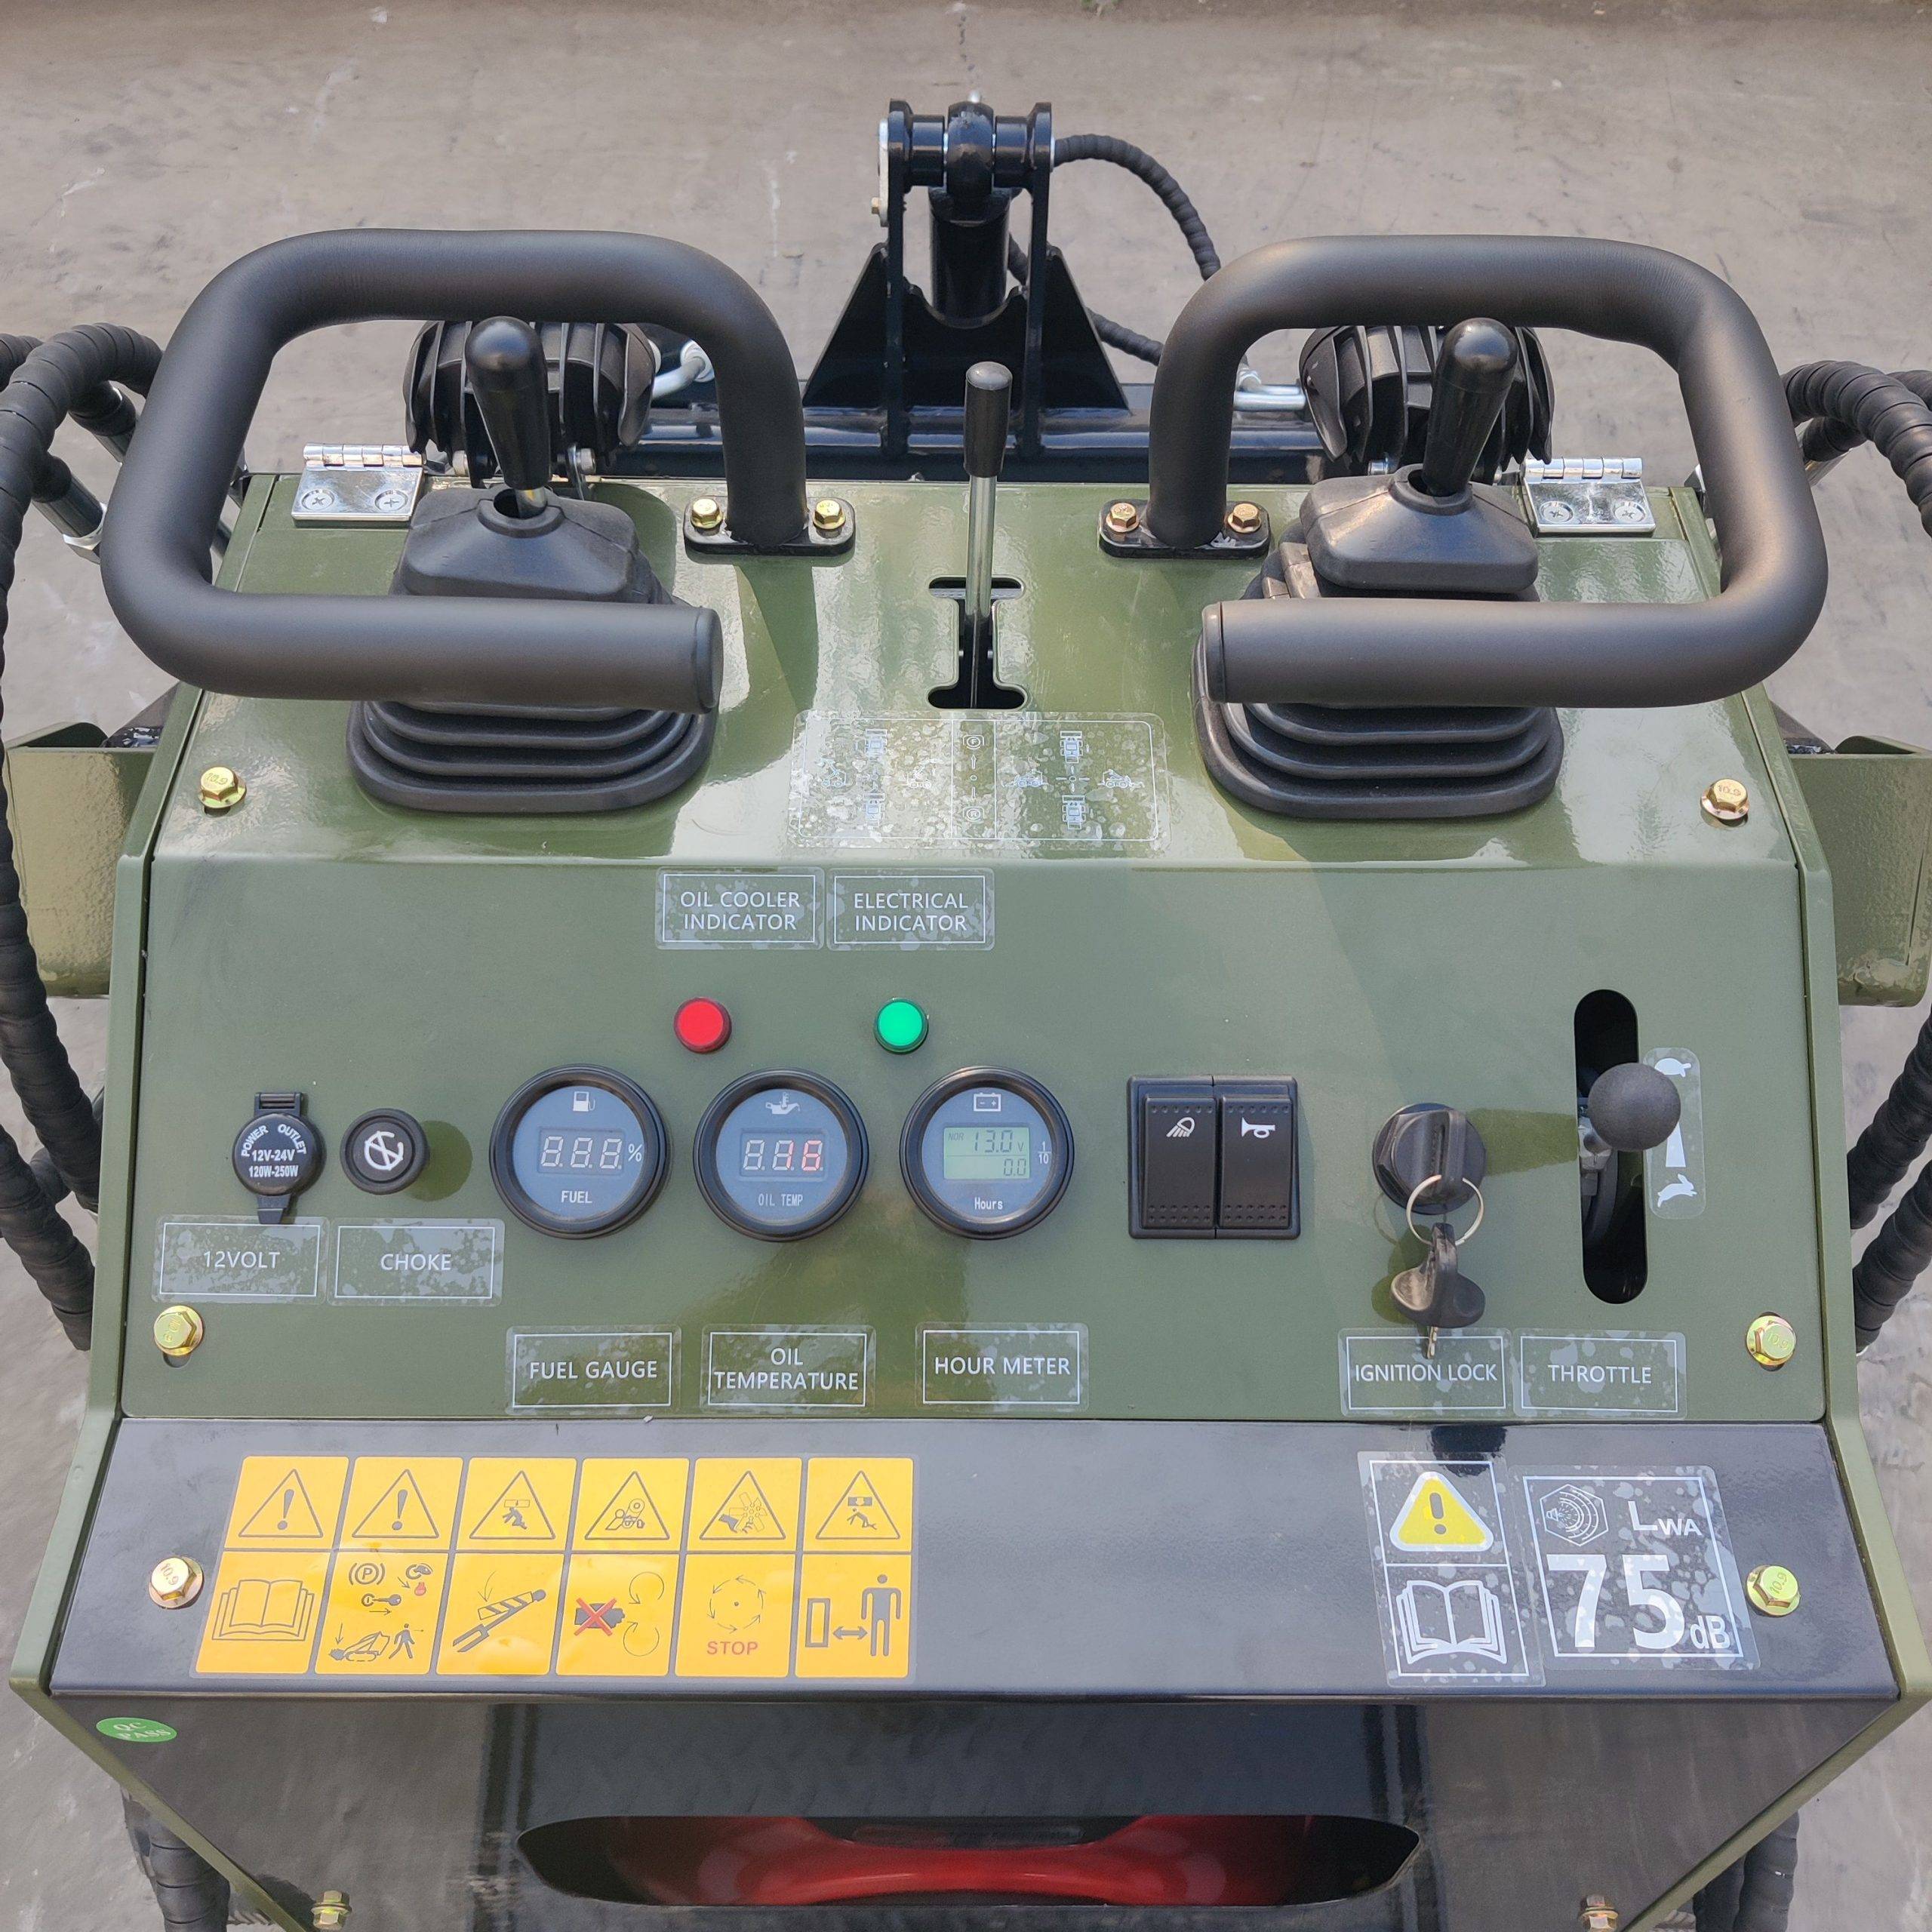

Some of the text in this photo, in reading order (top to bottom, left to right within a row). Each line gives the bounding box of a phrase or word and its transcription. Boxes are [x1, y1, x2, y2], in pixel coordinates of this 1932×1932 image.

[680, 891, 800, 908] OIL COOLER
[854, 893, 968, 909] ELECTRICAL
[684, 914, 796, 931] INDICATOR
[855, 915, 967, 931] INDICATOR
[241, 1123, 306, 1157] POWER OUTLET
[974, 1130, 1014, 1153] 13.0
[251, 1149, 295, 1162] 12V-24V
[248, 1164, 299, 1178] 120W-250W
[1003, 1158, 1027, 1177] 0.0
[561, 1190, 592, 1204] FUEL
[758, 1193, 804, 1207] OIL TEMP
[974, 1197, 1004, 1211] Hours
[203, 1251, 281, 1269] 12VOLT
[380, 1253, 452, 1271] CHOKE
[771, 1347, 804, 1365] OIL
[529, 1360, 657, 1380] FUEL GAUGE
[934, 1356, 1071, 1375] HOUR METER
[1355, 1363, 1498, 1383] IGNITION LOCK
[1548, 1364, 1652, 1385] THROTTLE
[714, 1371, 858, 1390] TEMPERATURE
[1546, 1553, 1730, 1650] 75 dB
[706, 1641, 758, 1656] STOP
[113, 1722, 146, 1731] QC
